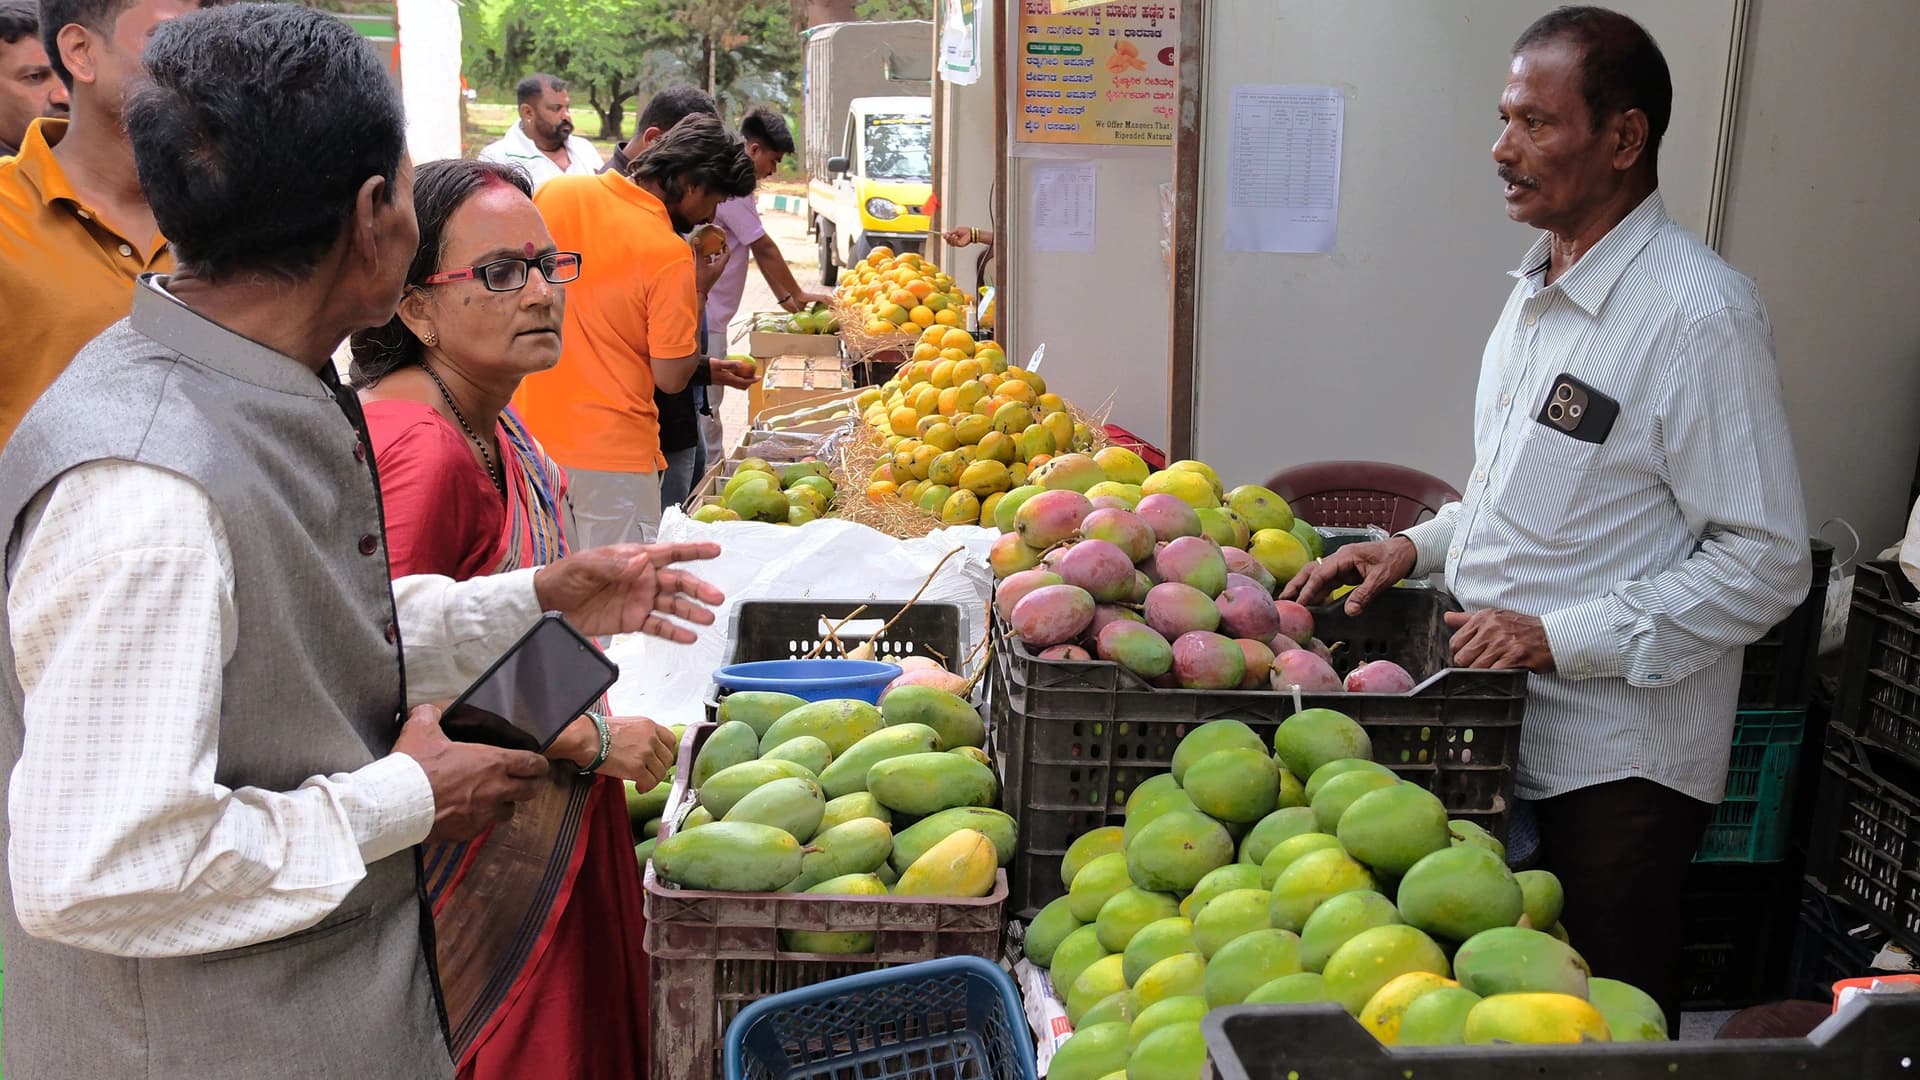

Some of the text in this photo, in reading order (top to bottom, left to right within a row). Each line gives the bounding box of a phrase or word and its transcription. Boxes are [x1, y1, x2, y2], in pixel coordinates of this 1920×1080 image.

[1106, 5, 1138, 18] ಮಾವಿನ
[1124, 28, 1163, 38] ಧಾರವಾಡ
[1096, 120, 1106, 129] We
[1107, 121, 1123, 129] Offer
[1155, 121, 1170, 130] That
